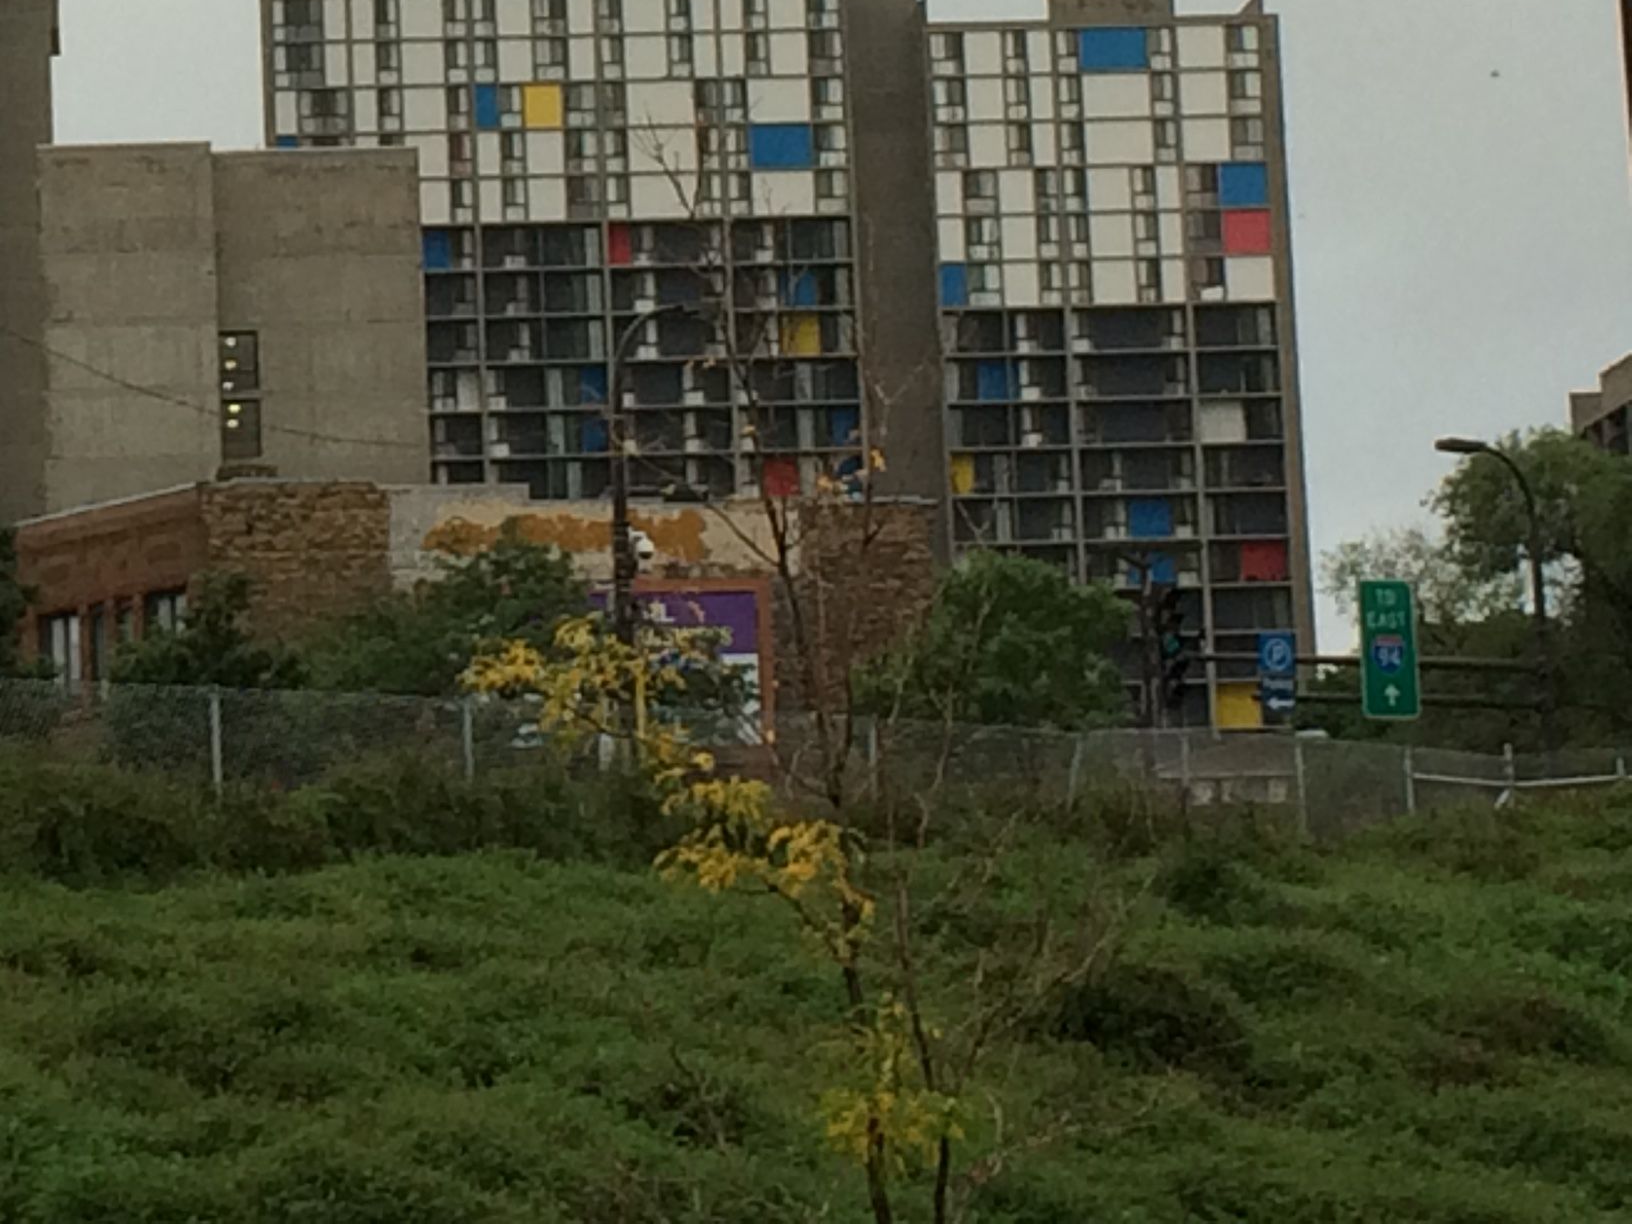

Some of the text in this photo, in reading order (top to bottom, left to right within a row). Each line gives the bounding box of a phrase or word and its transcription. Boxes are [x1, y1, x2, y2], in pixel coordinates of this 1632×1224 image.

[1374, 587, 1397, 606] TO
[1366, 610, 1407, 629] EAST
[1377, 647, 1402, 666] 94
